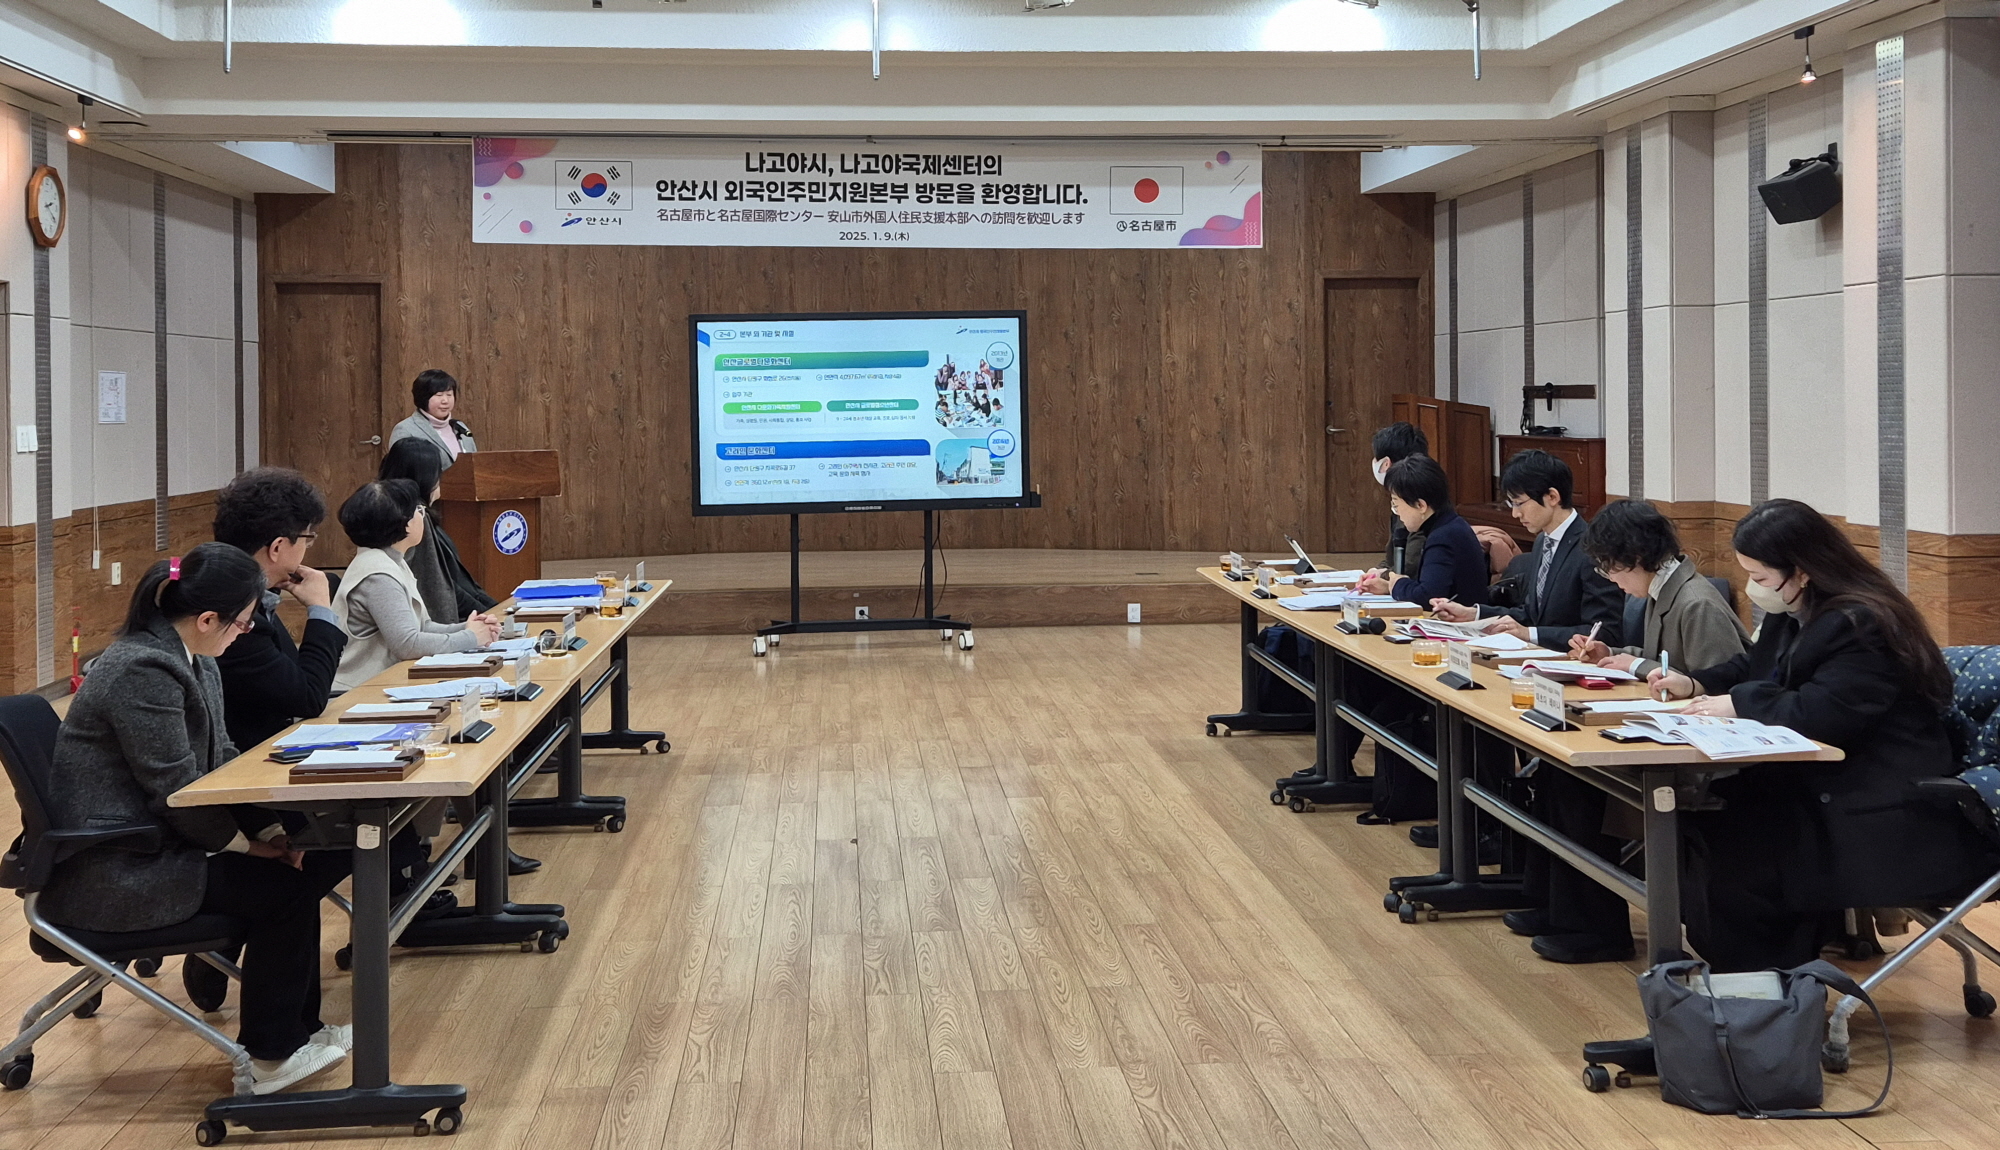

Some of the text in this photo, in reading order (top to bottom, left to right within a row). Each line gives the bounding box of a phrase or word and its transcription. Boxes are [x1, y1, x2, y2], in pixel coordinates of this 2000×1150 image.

[744, 152, 1003, 177] 나고야시, 나고야국제센터의
[655, 179, 1089, 205] 안산시 외국인주민지원본부 방문을 환영합니다.
[585, 216, 622, 226] 안산시
